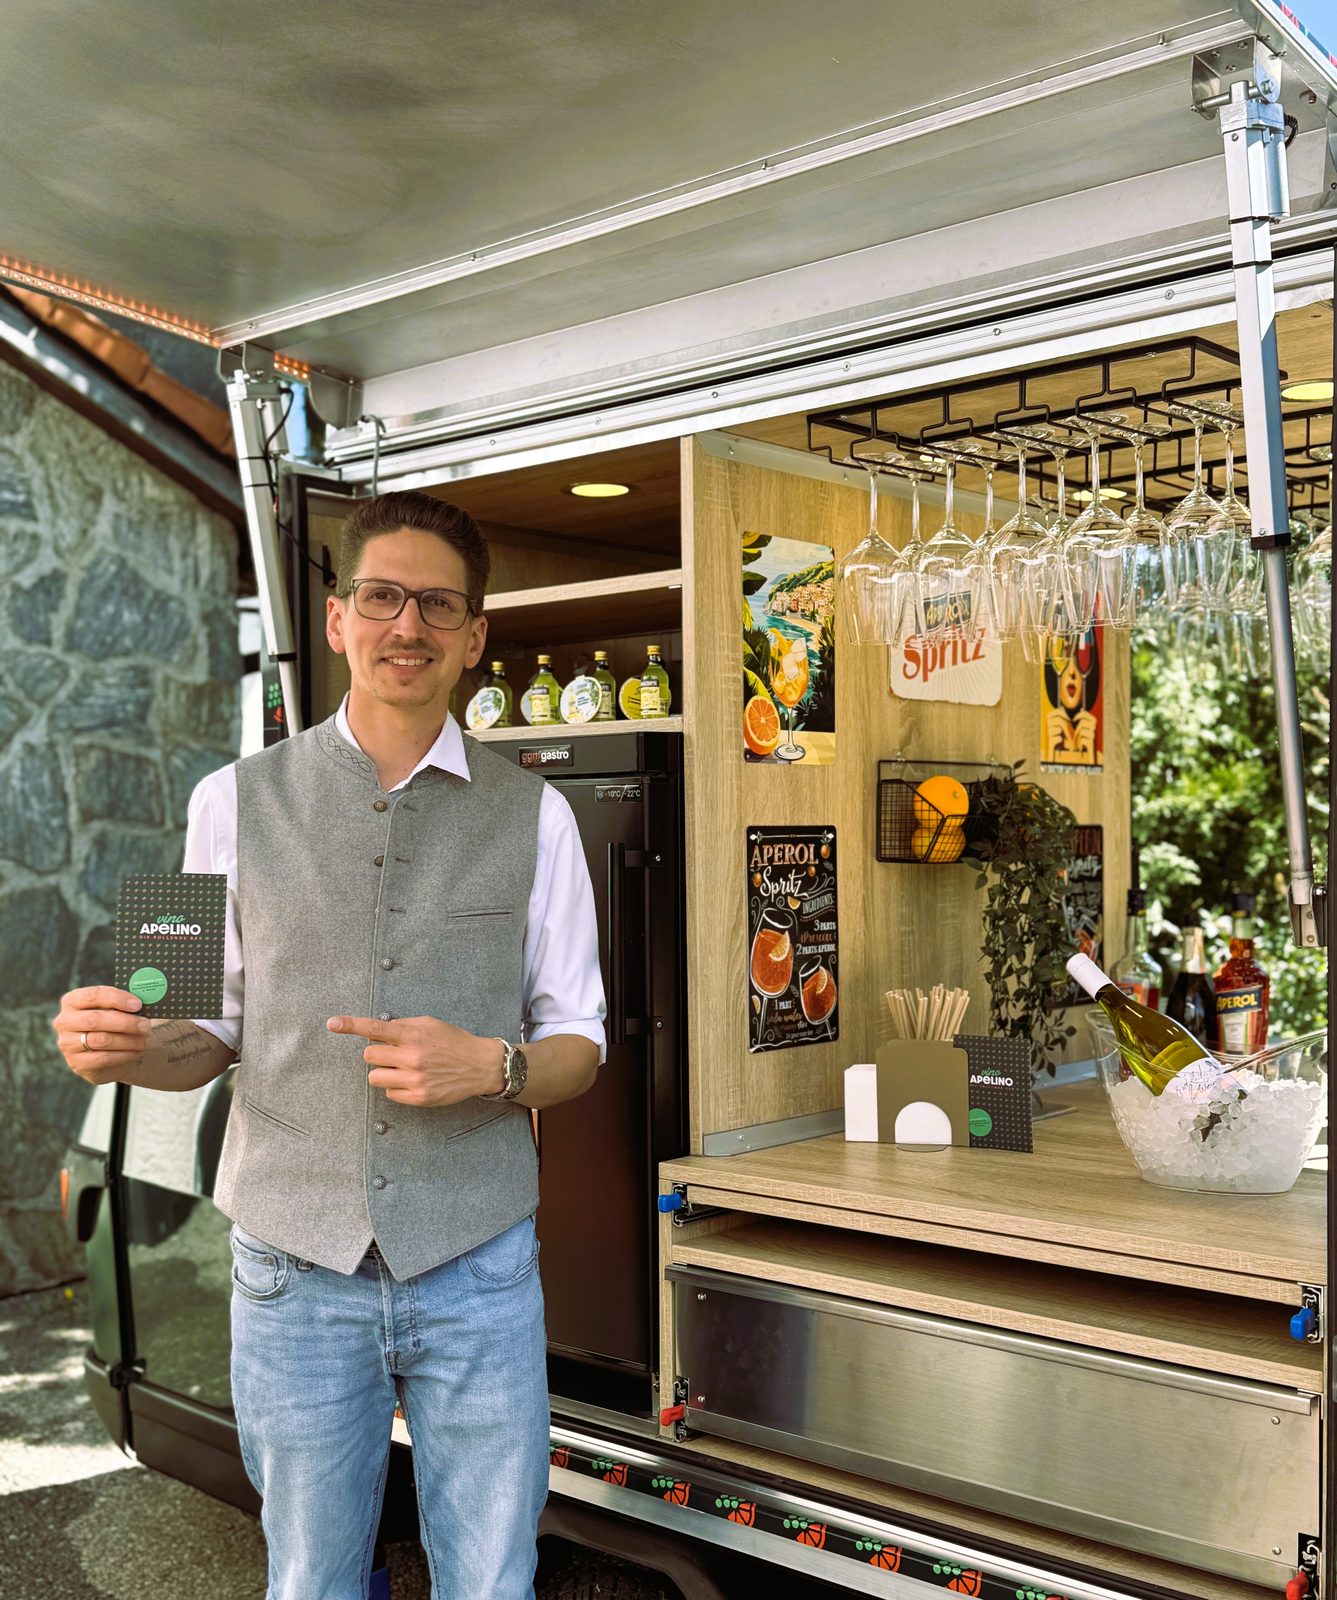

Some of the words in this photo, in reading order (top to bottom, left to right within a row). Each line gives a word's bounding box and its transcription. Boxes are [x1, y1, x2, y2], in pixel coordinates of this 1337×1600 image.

[902, 625, 986, 682] Spritz
[750, 844, 819, 867] APEROL
[760, 866, 810, 902] Spritz
[156, 912, 186, 924] vino
[813, 919, 820, 931] 3
[820, 921, 836, 931] PARTS
[796, 943, 803, 955] 2
[802, 945, 818, 955] PARTS
[818, 944, 836, 953] APEROL
[779, 1000, 792, 1010] PART
[1216, 993, 1258, 1011] APEROL
[980, 1067, 1002, 1076] vino
